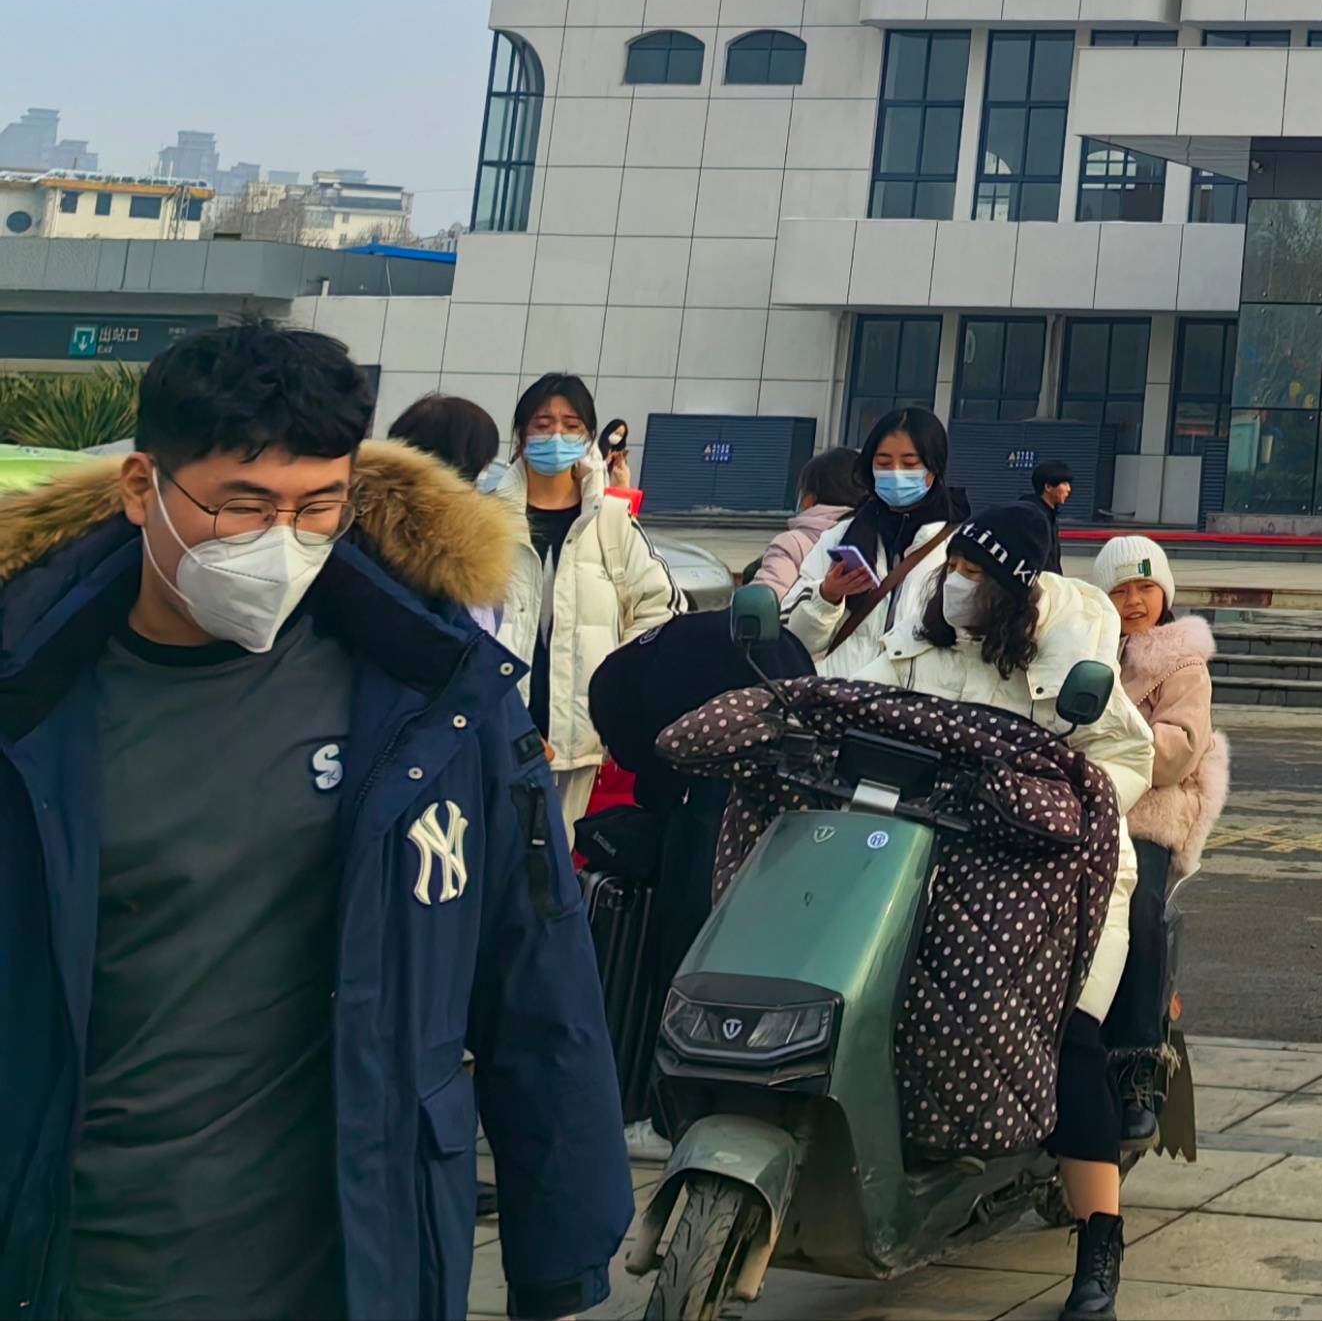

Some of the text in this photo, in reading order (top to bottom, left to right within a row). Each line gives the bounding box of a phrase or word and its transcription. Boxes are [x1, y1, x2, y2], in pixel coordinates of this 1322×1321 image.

[99, 327, 139, 342] 出站口
[407, 799, 469, 905] NY
